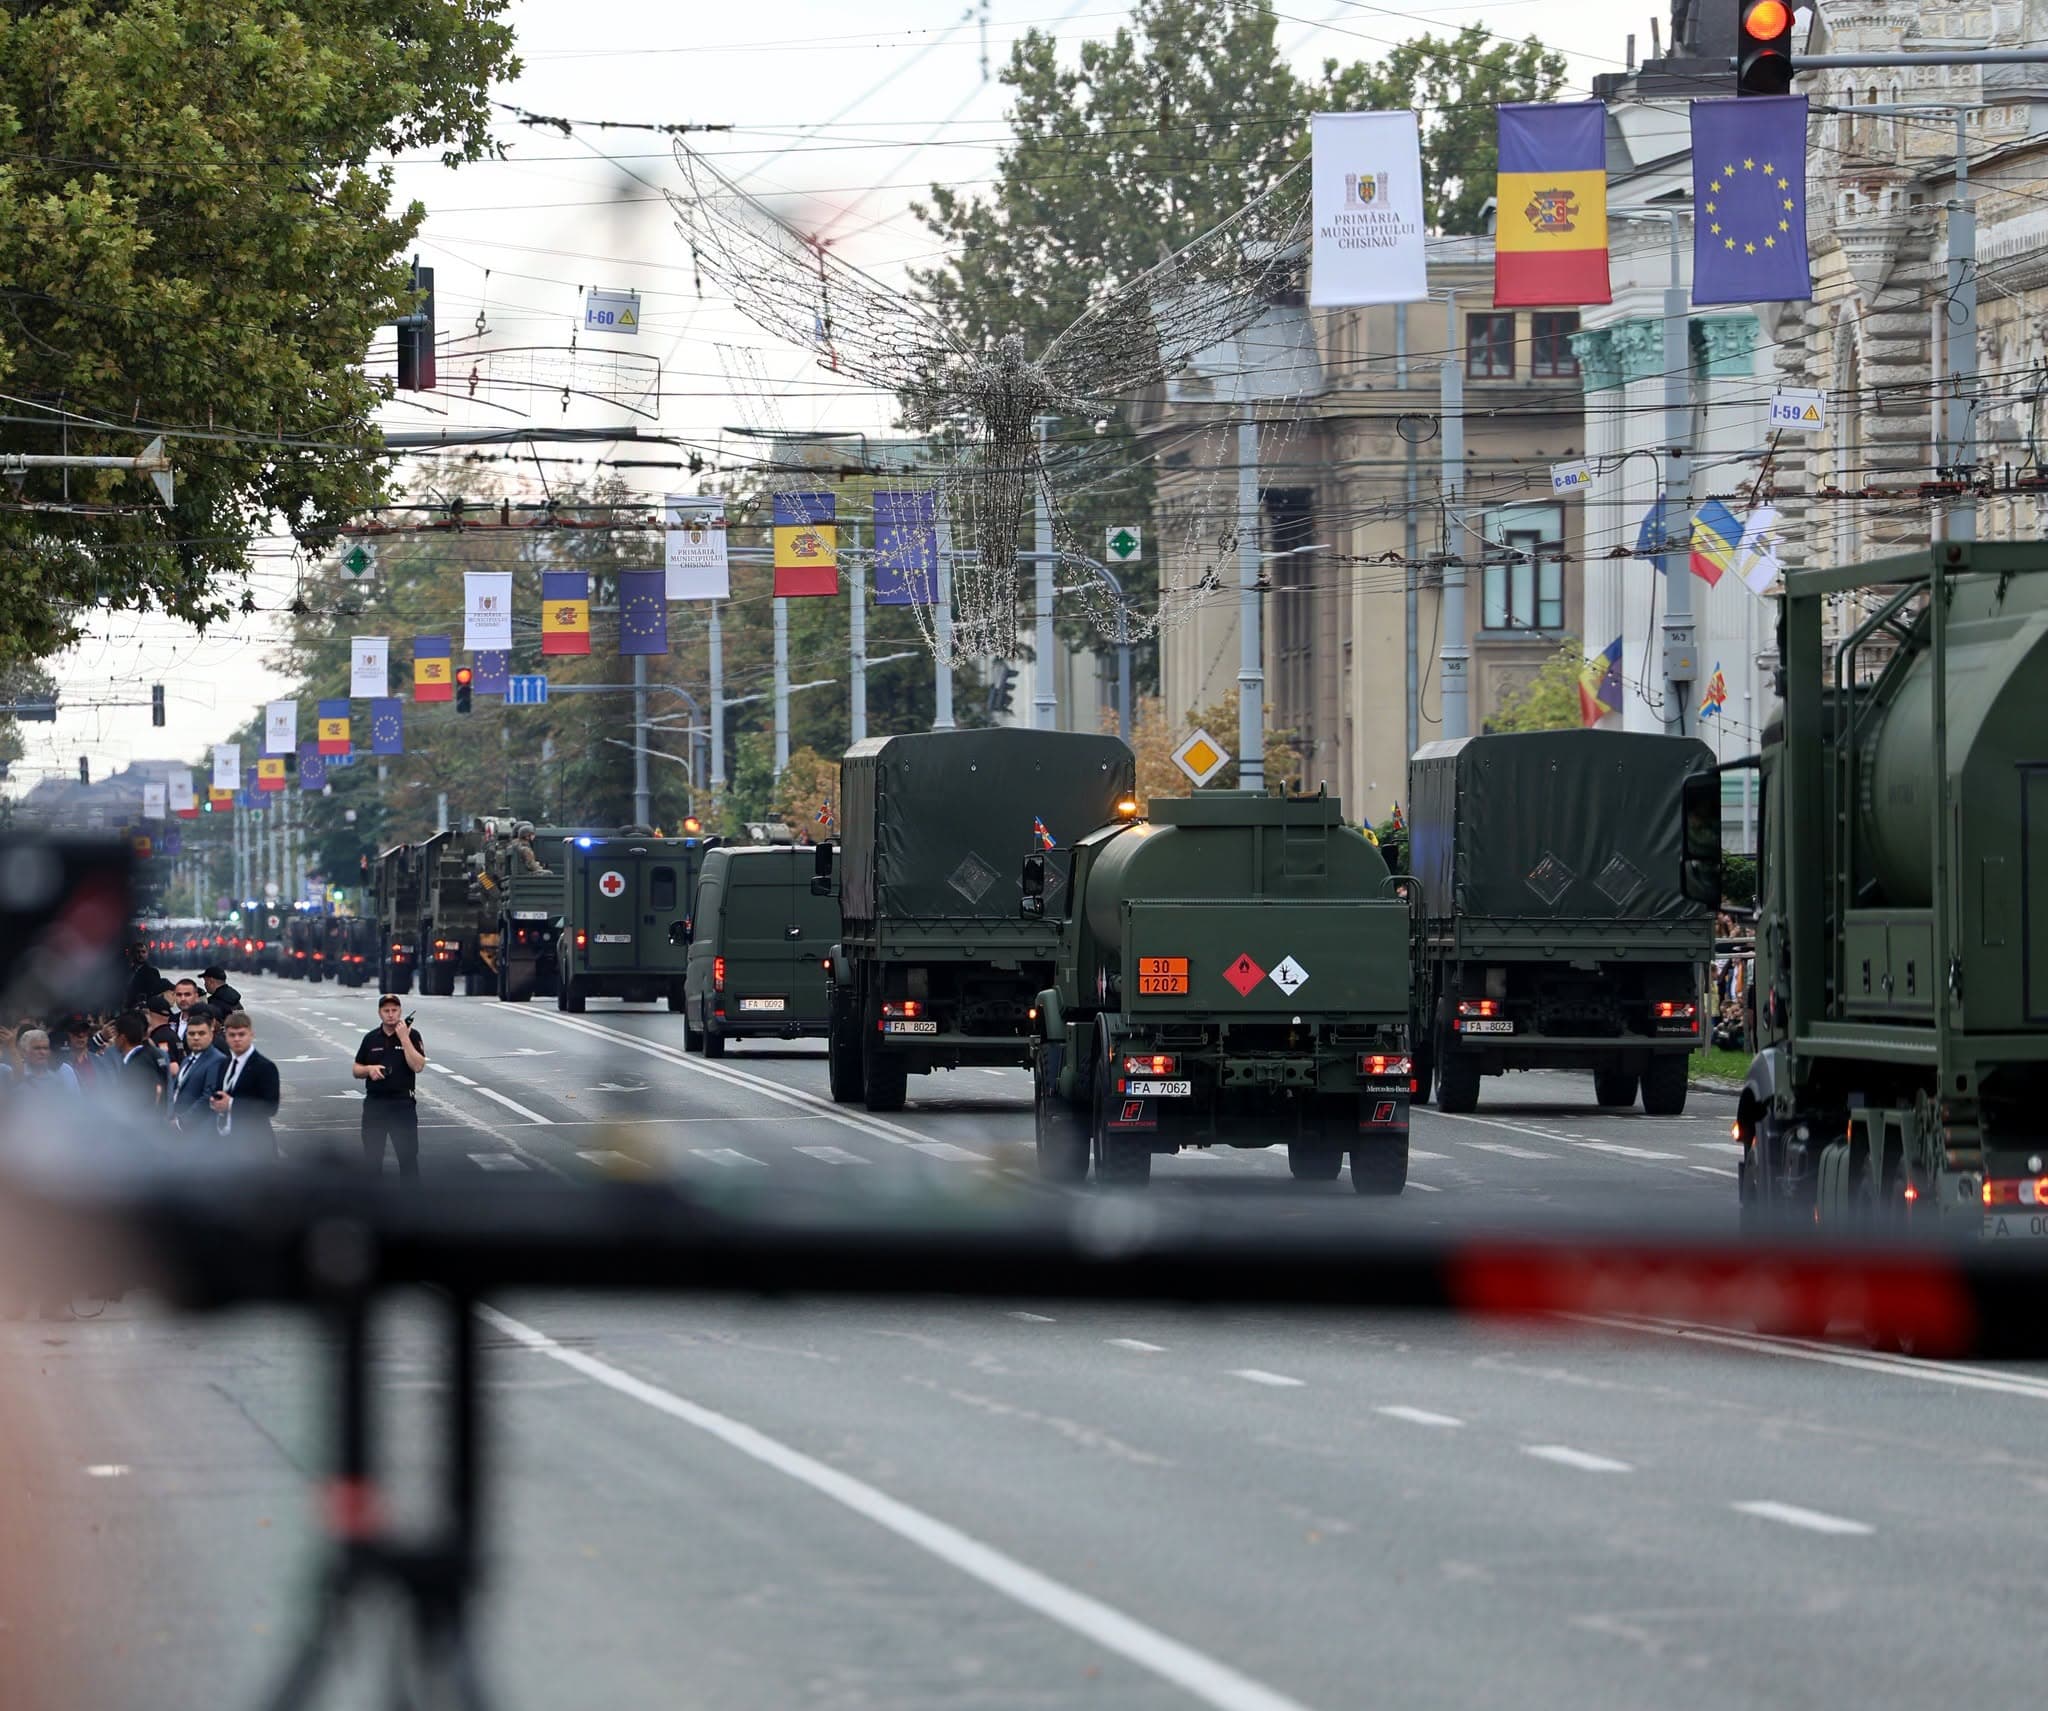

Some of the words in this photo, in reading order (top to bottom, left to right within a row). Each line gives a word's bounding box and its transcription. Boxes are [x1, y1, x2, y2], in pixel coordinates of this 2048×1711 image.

[1320, 223, 1415, 239] MUNICIPIULUI
[588, 309, 614, 325] I-60
[1772, 404, 1801, 420] I-59
[1555, 473, 1578, 488] C-80
[1153, 960, 1169, 973] 30
[1144, 978, 1178, 992] 1202
[894, 1022, 906, 1032] FA
[913, 1022, 935, 1032] 8022
[1470, 1022, 1482, 1031] FA
[1133, 1082, 1151, 1094] FA
[1160, 1082, 1188, 1094] 7062
